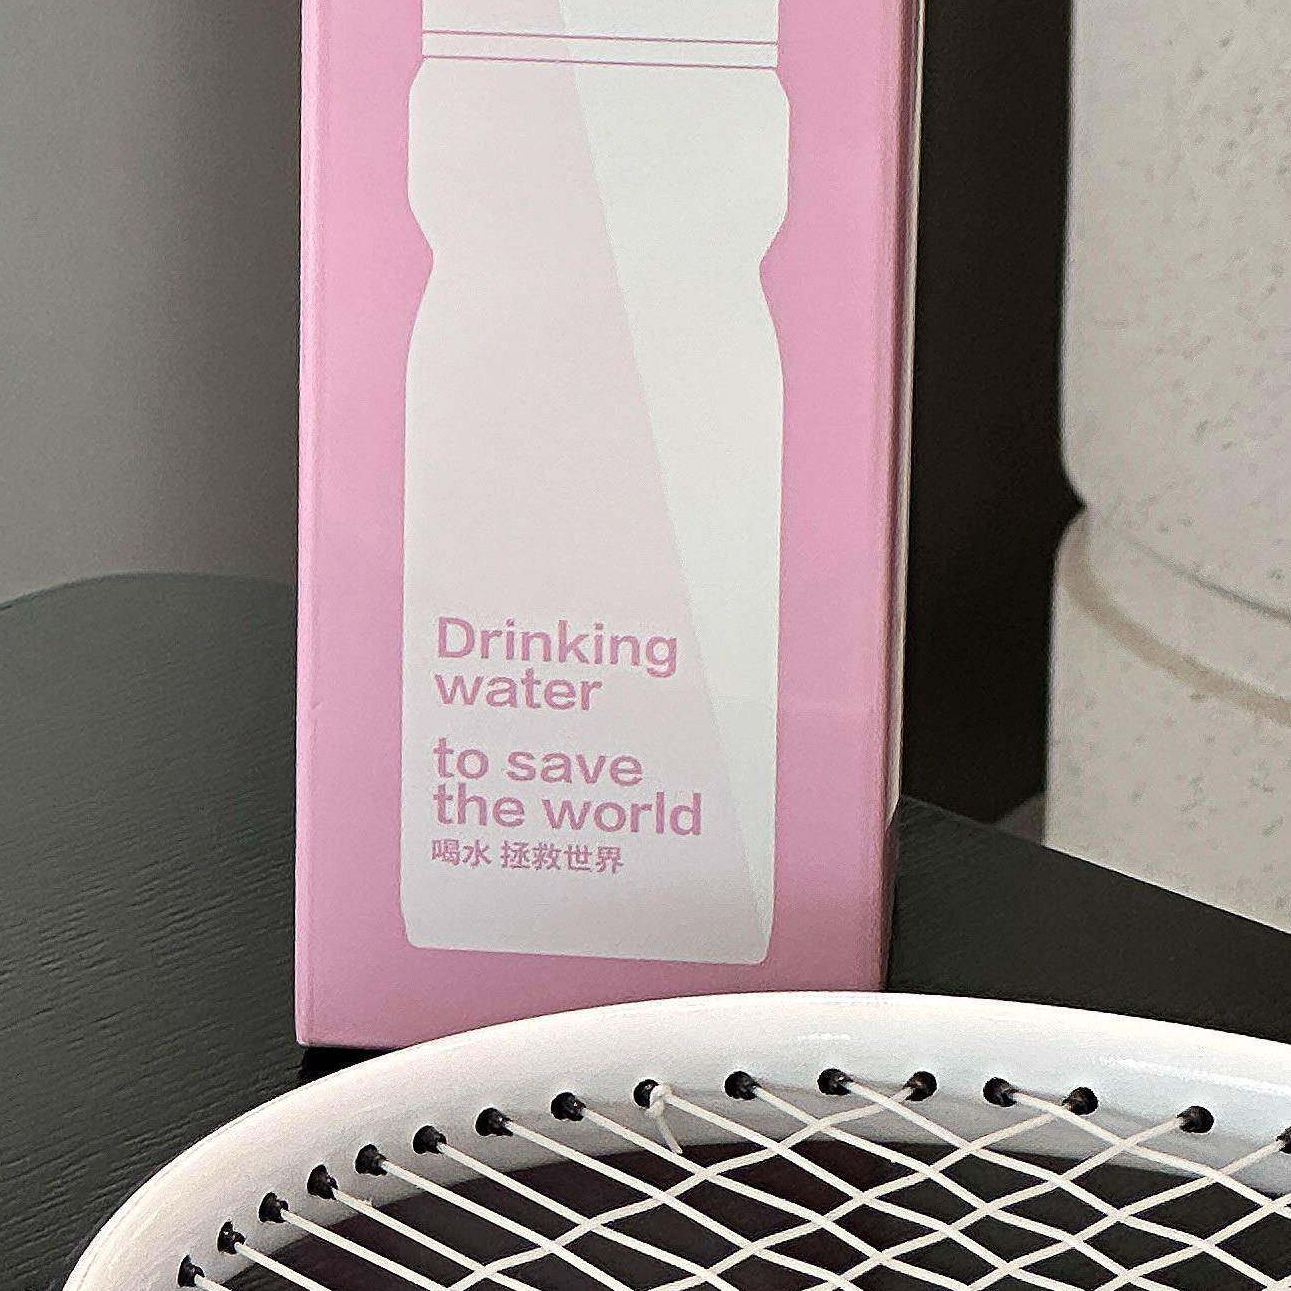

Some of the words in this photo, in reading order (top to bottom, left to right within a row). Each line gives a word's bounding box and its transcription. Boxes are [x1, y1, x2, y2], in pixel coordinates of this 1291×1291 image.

[437, 616, 677, 678] Drinking
[434, 667, 603, 711] water
[432, 737, 489, 780] to
[507, 750, 644, 787] save
[433, 782, 526, 828] the
[541, 792, 703, 836] world
[431, 839, 492, 867] 喝水
[500, 839, 624, 874] 拯救世界
